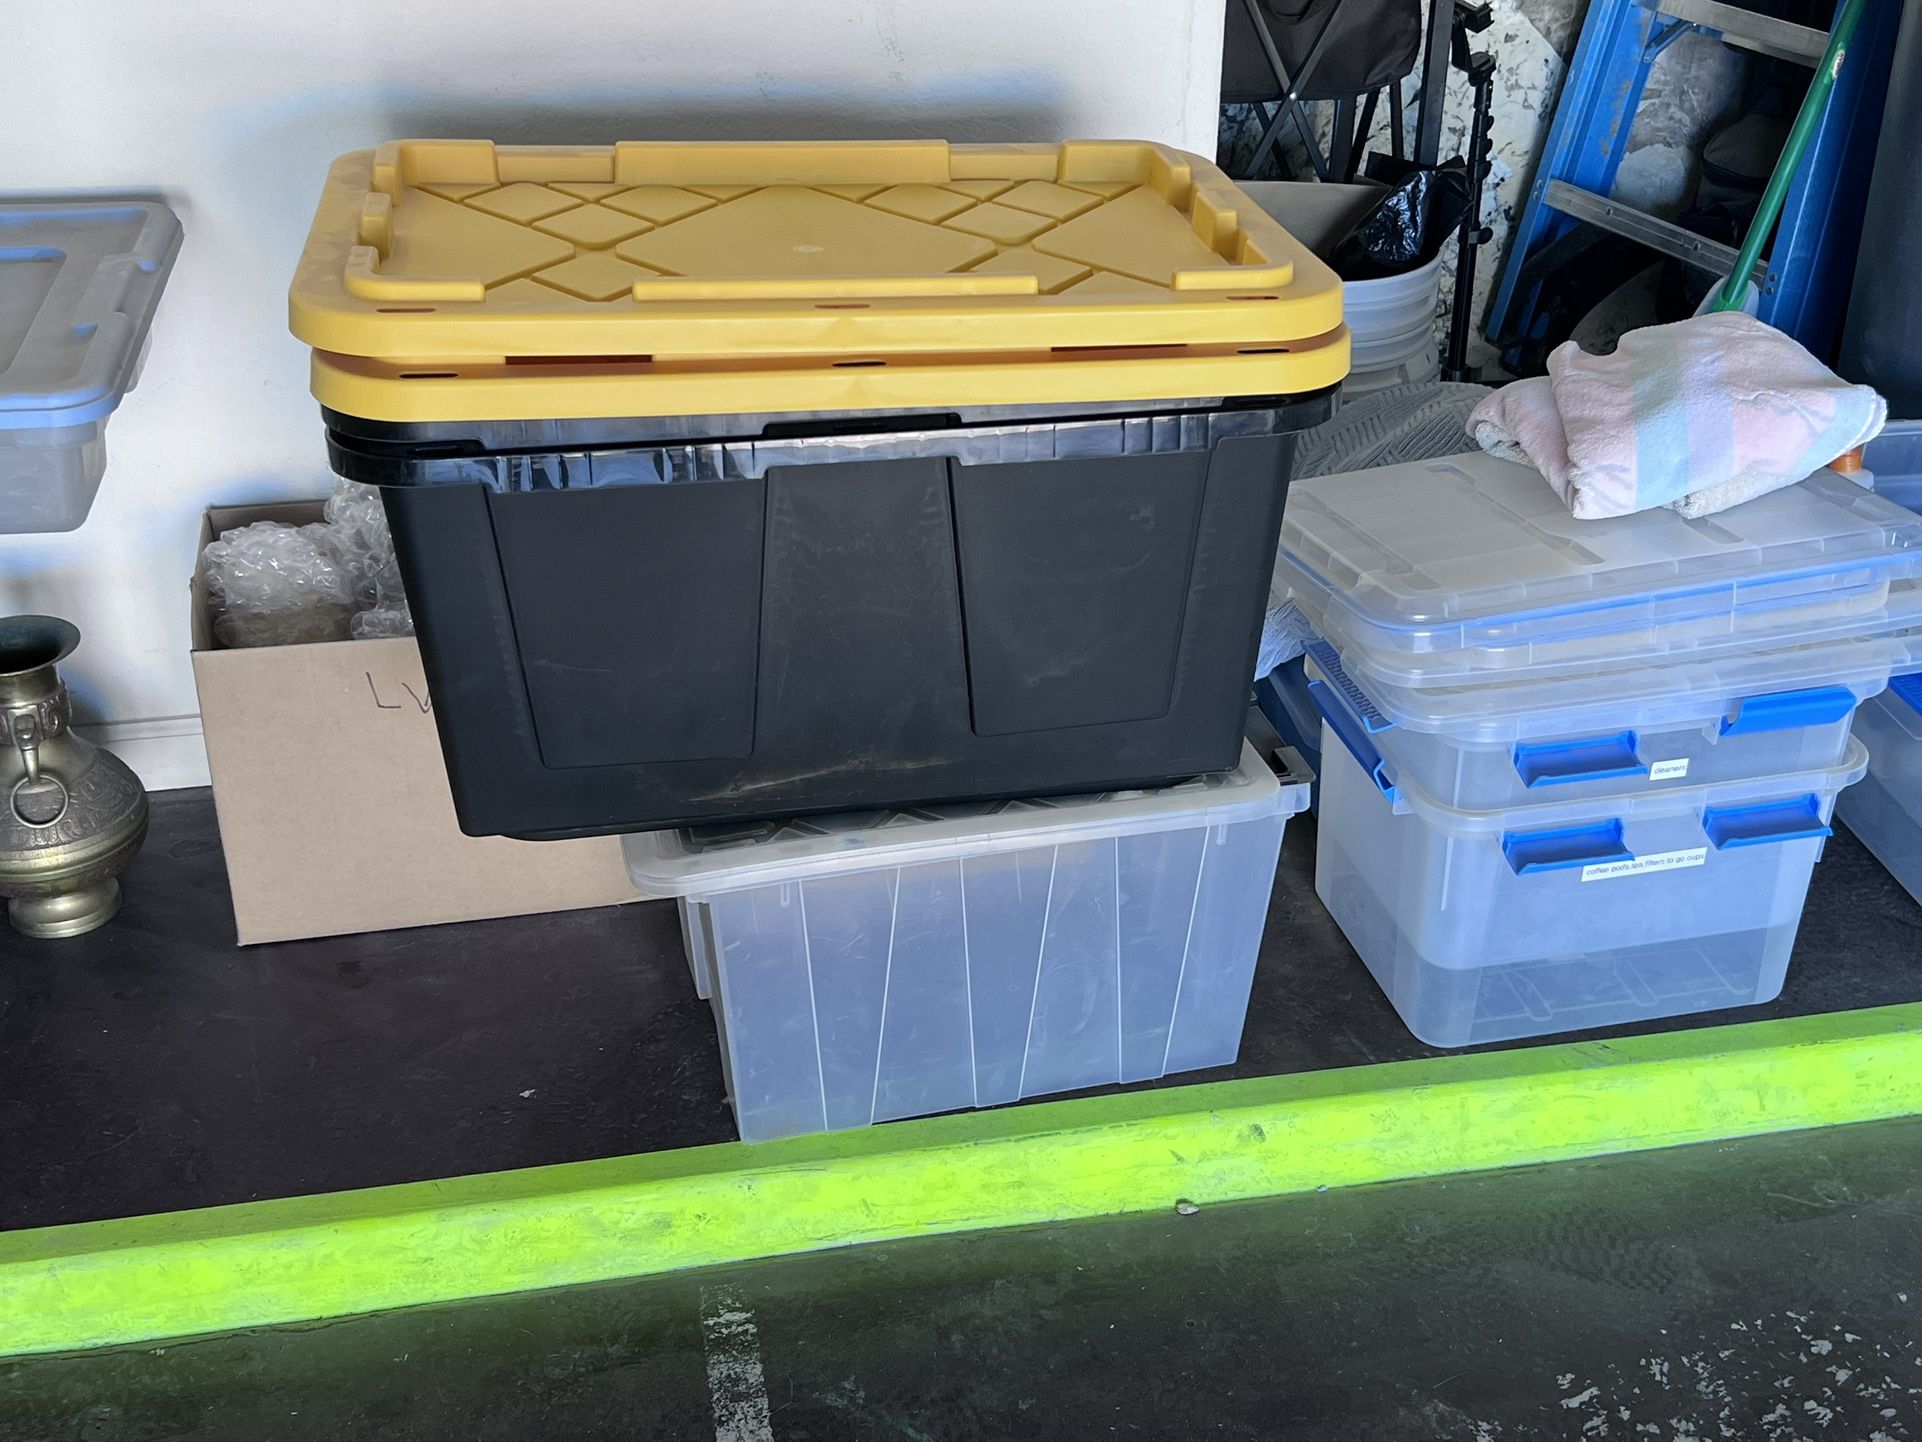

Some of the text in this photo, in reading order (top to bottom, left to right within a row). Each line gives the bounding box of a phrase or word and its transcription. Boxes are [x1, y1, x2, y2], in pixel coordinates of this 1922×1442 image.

[1654, 764, 1686, 775] cleaners
[1586, 866, 1610, 876] coffee
[1675, 856, 1686, 864] go
[1686, 853, 1705, 862] cups
